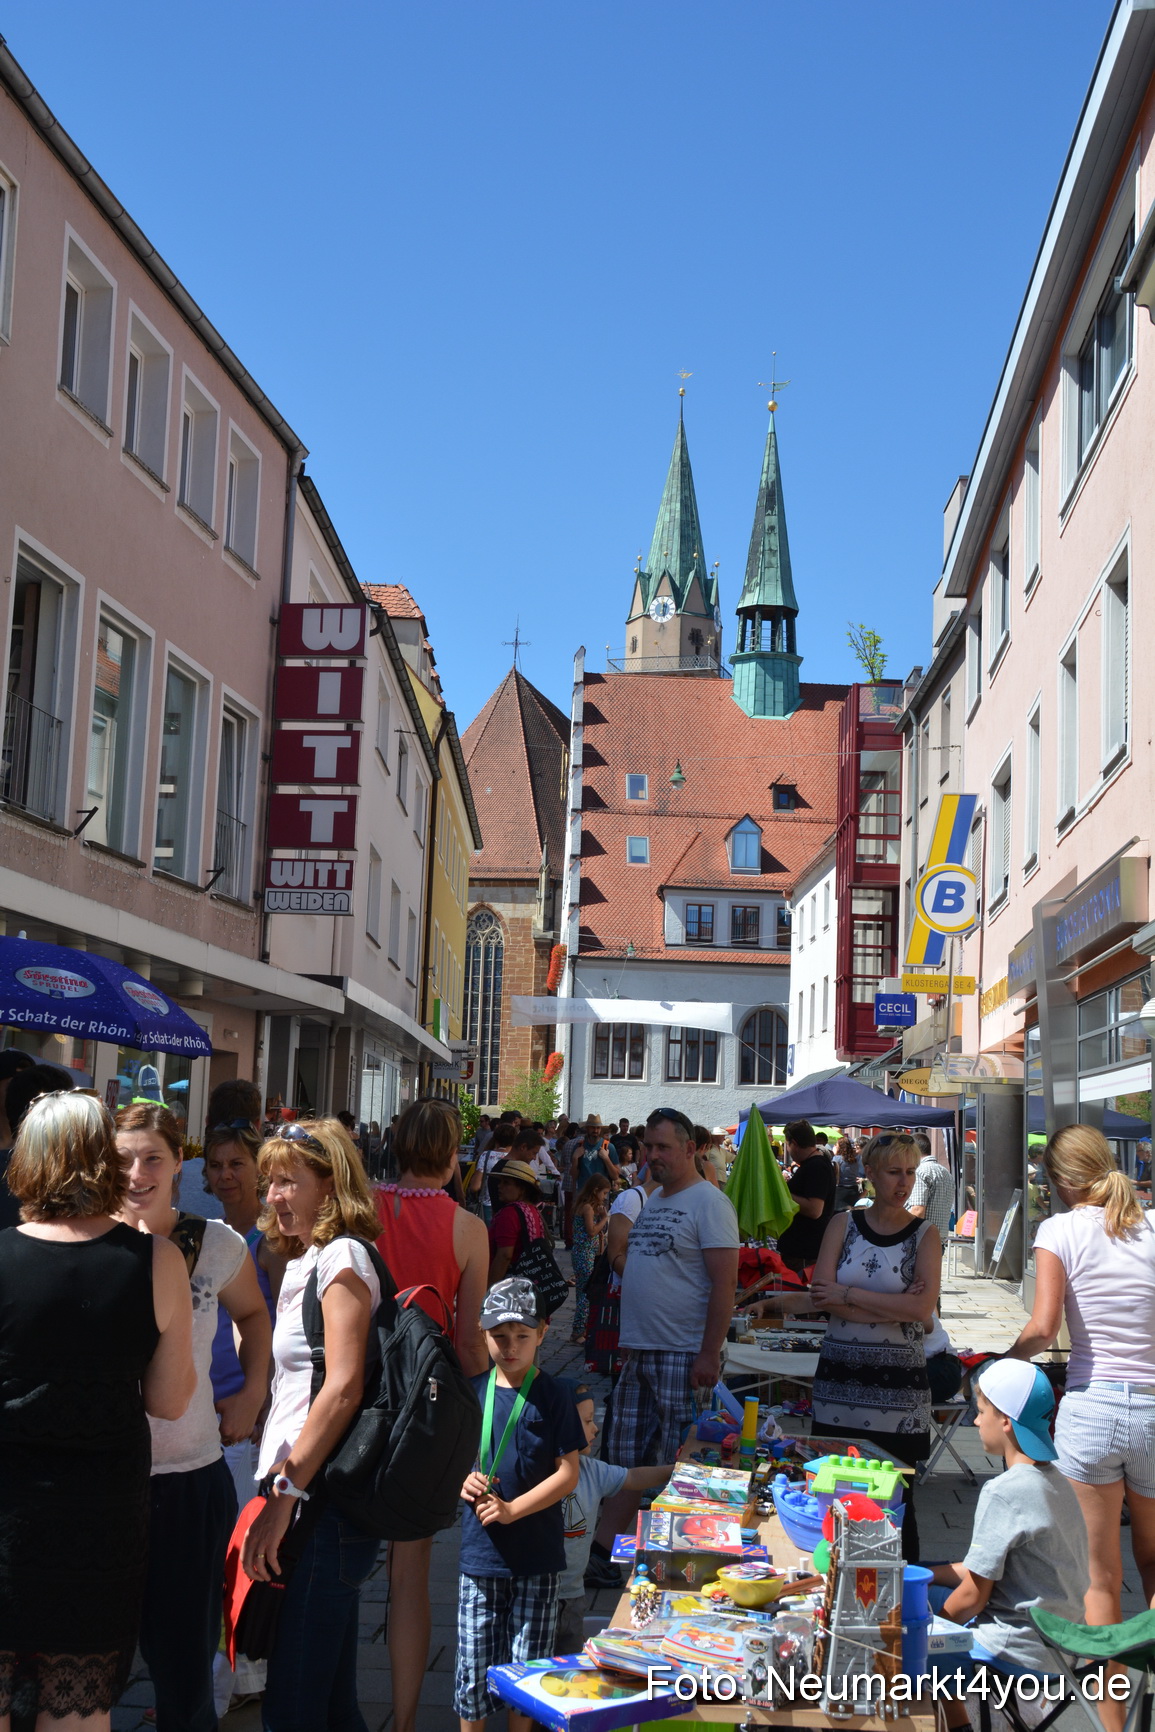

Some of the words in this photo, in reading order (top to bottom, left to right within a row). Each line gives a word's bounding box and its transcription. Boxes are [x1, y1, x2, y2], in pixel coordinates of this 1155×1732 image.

[299, 608, 361, 843] WITT
[270, 860, 350, 888] WITT
[266, 891, 350, 912] WEIDEN
[931, 880, 966, 914] B
[32, 979, 80, 993] SPRUDEL
[905, 979, 964, 989] KLOSTERGASE
[878, 1003, 911, 1013] CECIL
[8, 1008, 58, 1025] Schatz
[60, 1015, 86, 1031] der
[88, 1021, 131, 1039] Rhön.
